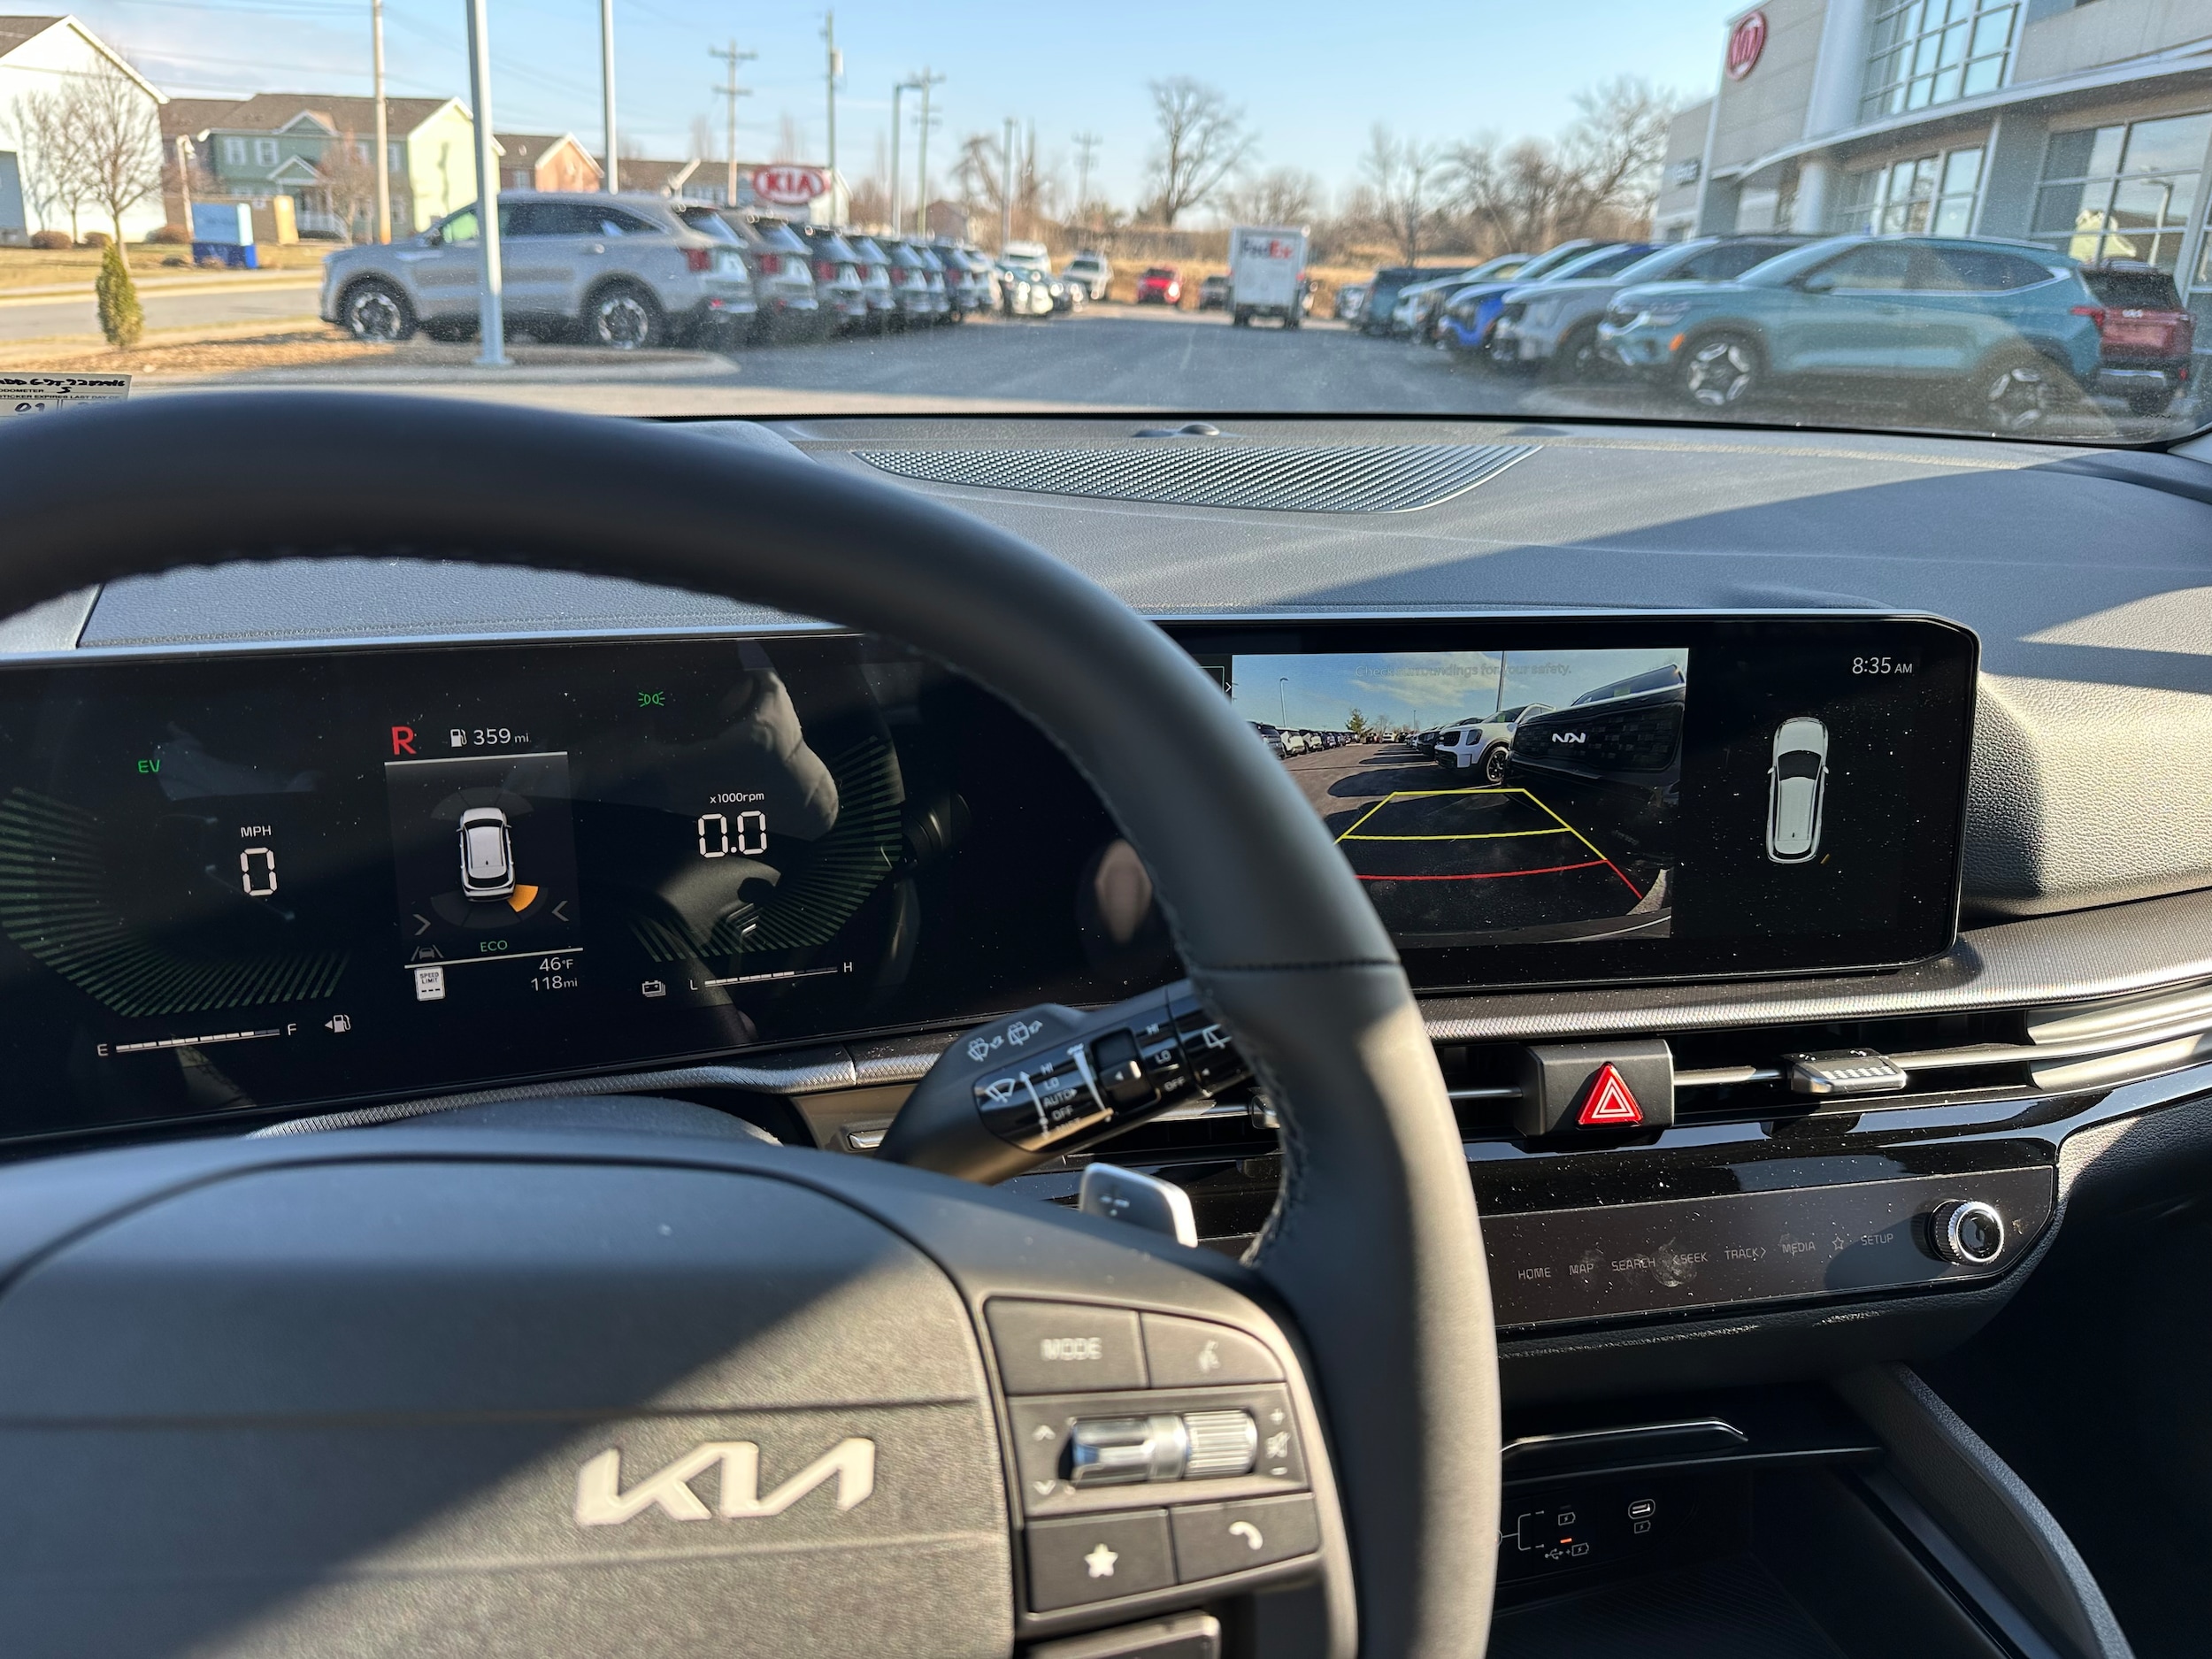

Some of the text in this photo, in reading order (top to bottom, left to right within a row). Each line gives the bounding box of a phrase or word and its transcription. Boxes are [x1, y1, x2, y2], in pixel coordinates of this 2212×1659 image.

[765, 172, 814, 196] KIA
[1355, 663, 1572, 679] Check surroundings for your safety.
[1852, 657, 1912, 674] 8:35 AM
[391, 726, 417, 755] R
[473, 728, 529, 745] 359 mi
[138, 760, 160, 773] EV
[710, 793, 764, 803] x1000rpm
[240, 826, 272, 837] MPH
[698, 810, 767, 858] 0.0
[240, 847, 277, 896] 0
[480, 941, 508, 952] ECO
[539, 957, 574, 972] 46°F
[843, 962, 853, 972] H
[689, 979, 698, 991] L
[287, 1023, 297, 1036] F
[96, 1043, 109, 1056] E
[1155, 1050, 1171, 1064] LO
[1041, 1063, 1054, 1075] HI
[1044, 1076, 1060, 1091] LO
[1164, 1076, 1185, 1092] OFF
[1043, 1089, 1072, 1108] AUTO
[1051, 1104, 1073, 1121] OFF
[1861, 1233, 1893, 1246] SETUP
[1782, 1241, 1816, 1254] MEDIA
[1569, 1262, 1594, 1276] MAP
[1611, 1256, 1655, 1271] SEARCH
[1517, 1266, 1551, 1280] HOME
[1041, 1337, 1102, 1361] MODE
[575, 1437, 876, 1527] KIA
